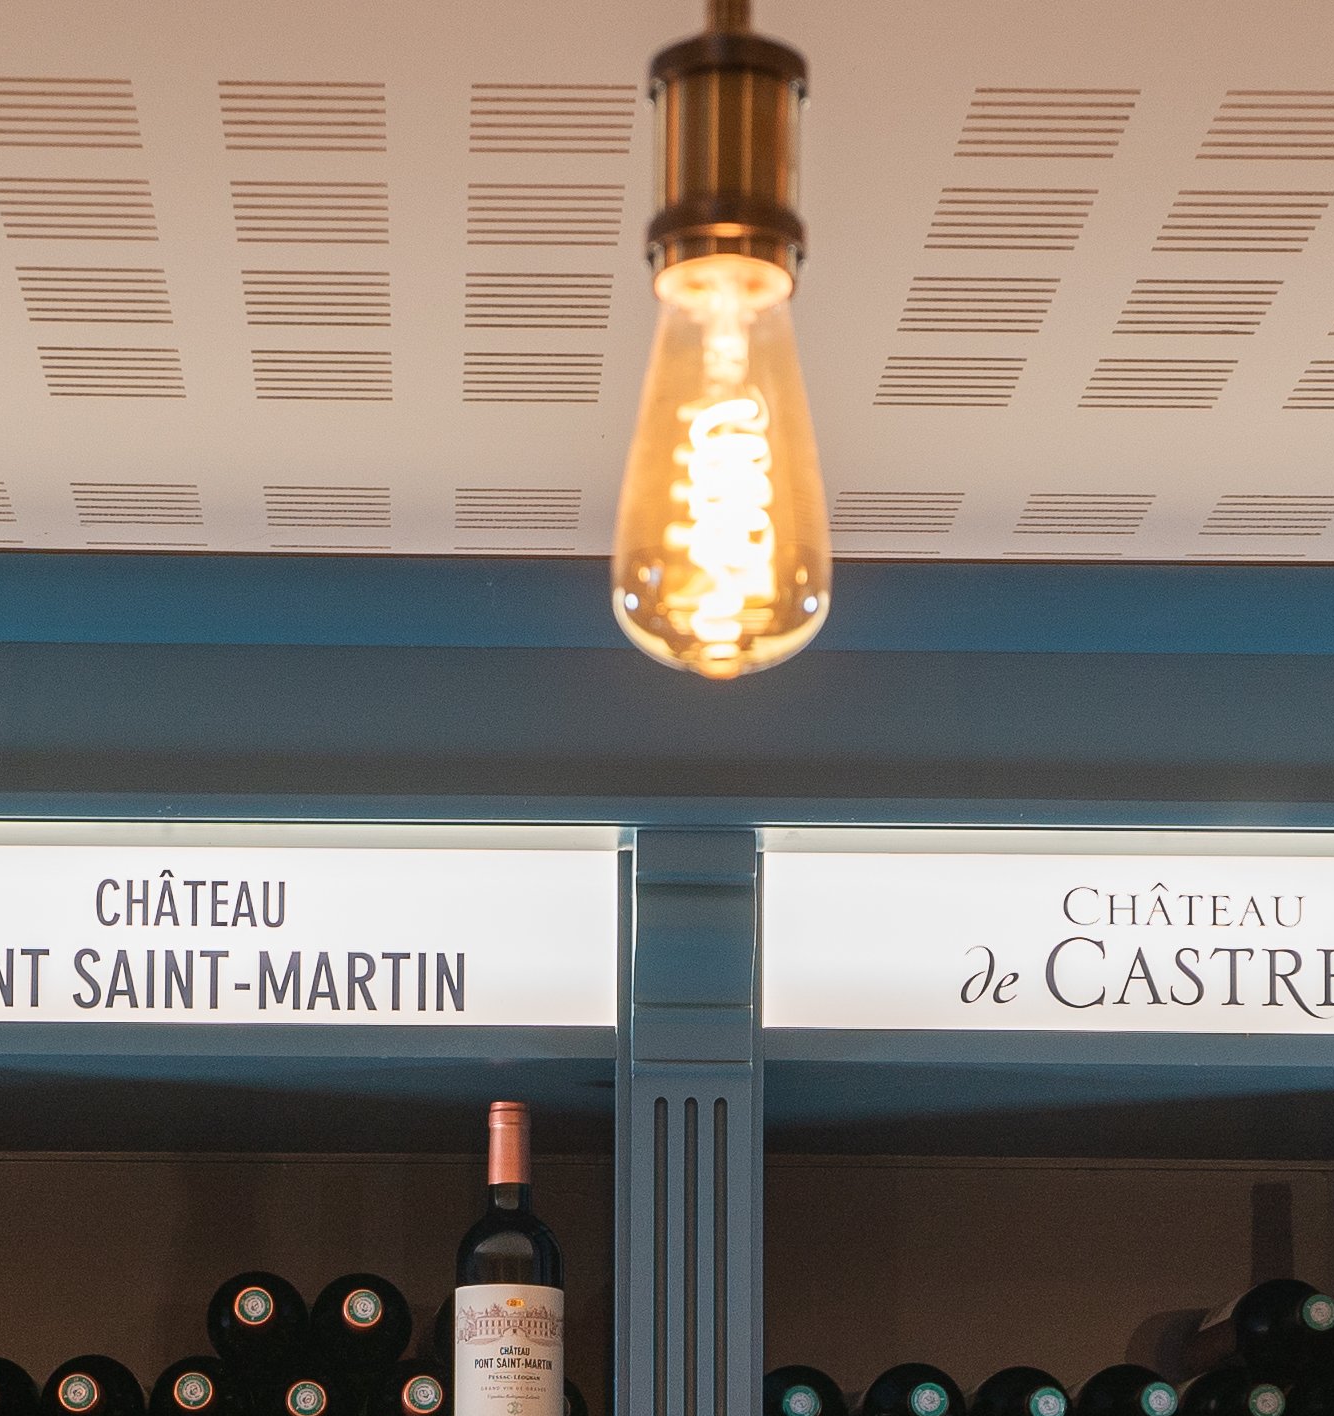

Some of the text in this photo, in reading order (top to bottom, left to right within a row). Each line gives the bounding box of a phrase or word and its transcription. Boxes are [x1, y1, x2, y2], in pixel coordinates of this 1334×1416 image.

[95, 868, 287, 928] CHÂTEAU
[1062, 881, 1307, 928] CHÂTEAU
[72, 948, 466, 1012] SAINT-MARTIN
[959, 944, 1021, 1004] de
[474, 1357, 553, 1371] PONT SAINT-MARTIN
[499, 1345, 531, 1356] CHÂTEAU
